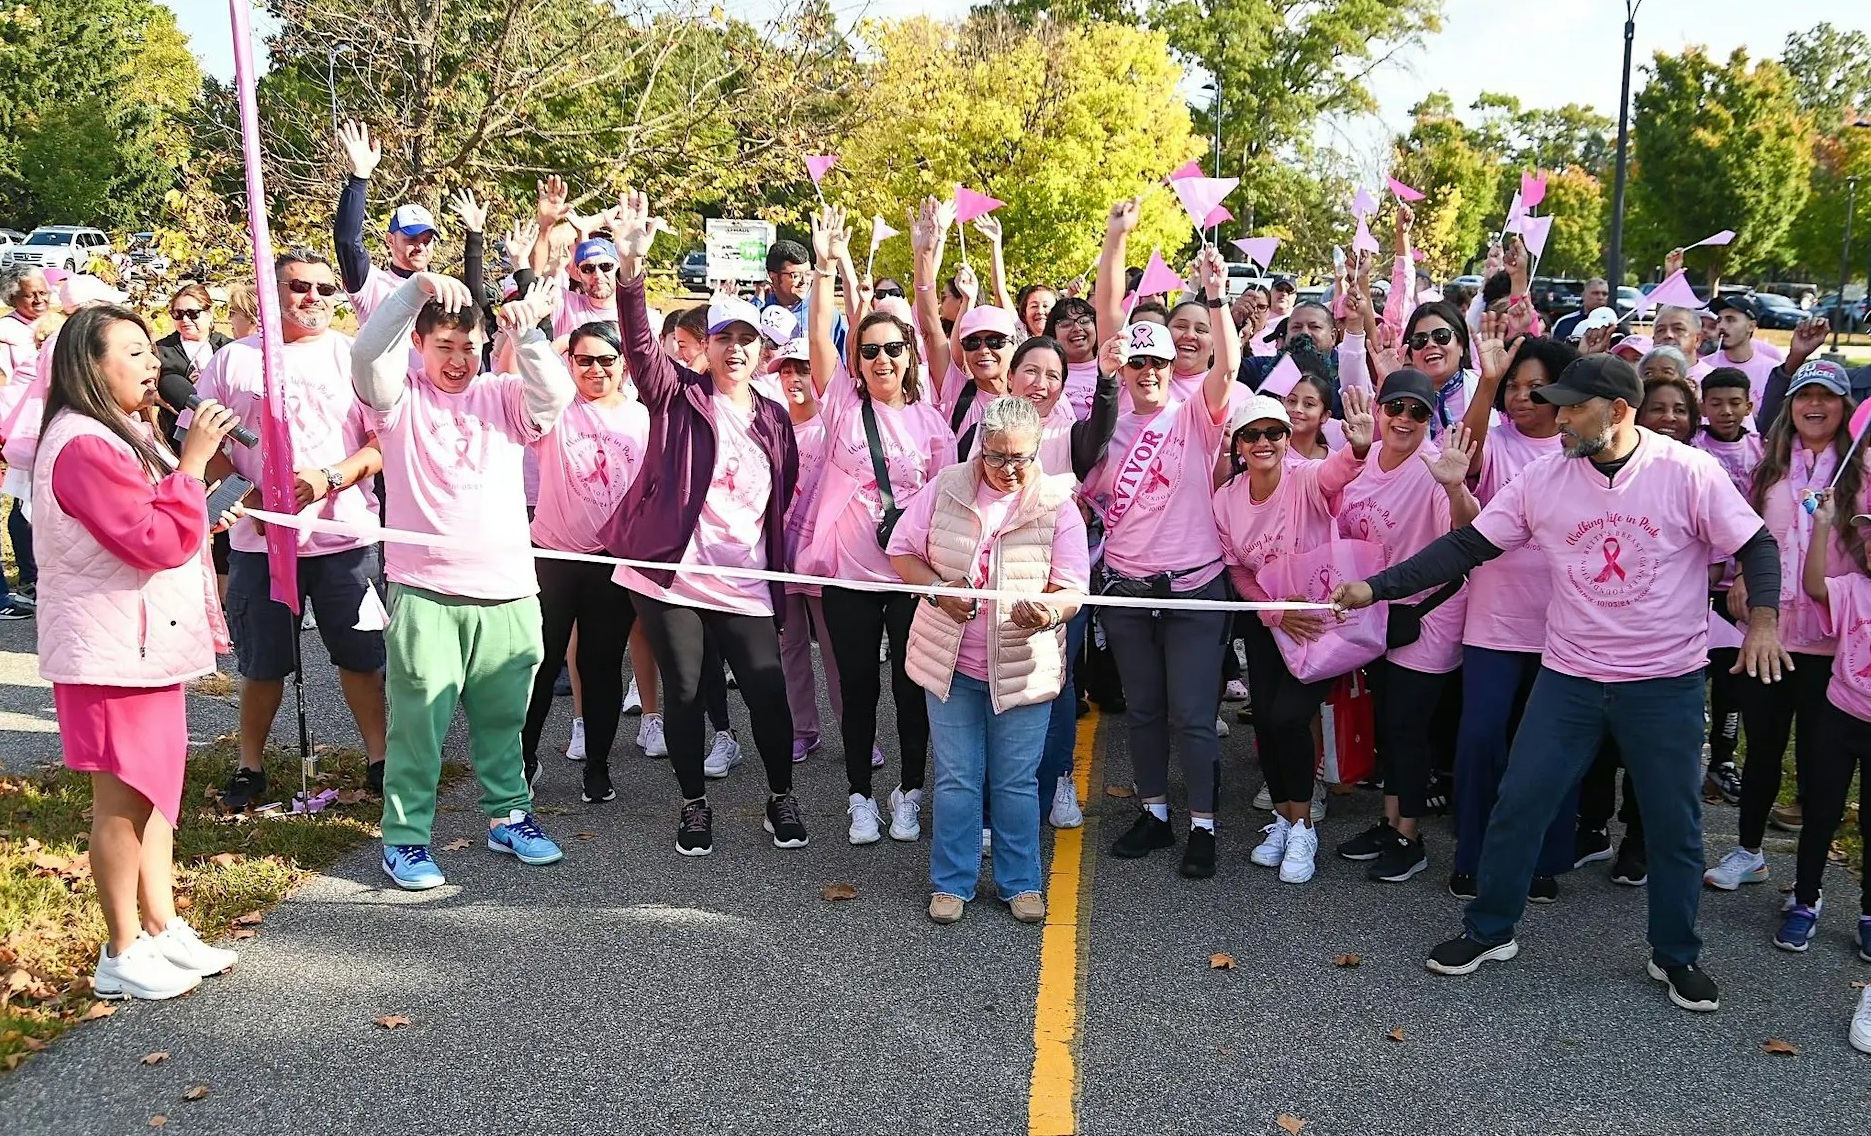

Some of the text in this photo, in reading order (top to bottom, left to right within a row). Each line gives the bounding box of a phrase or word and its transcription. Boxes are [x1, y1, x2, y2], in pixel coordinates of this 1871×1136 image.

[1798, 370, 1836, 381] CANCER
[1105, 430, 1164, 530] URVIVOR
[1566, 518, 1604, 546] Walking
[1626, 515, 1636, 525] in
[1639, 516, 1661, 538] Pink
[1722, 712, 1738, 739] DKNY
